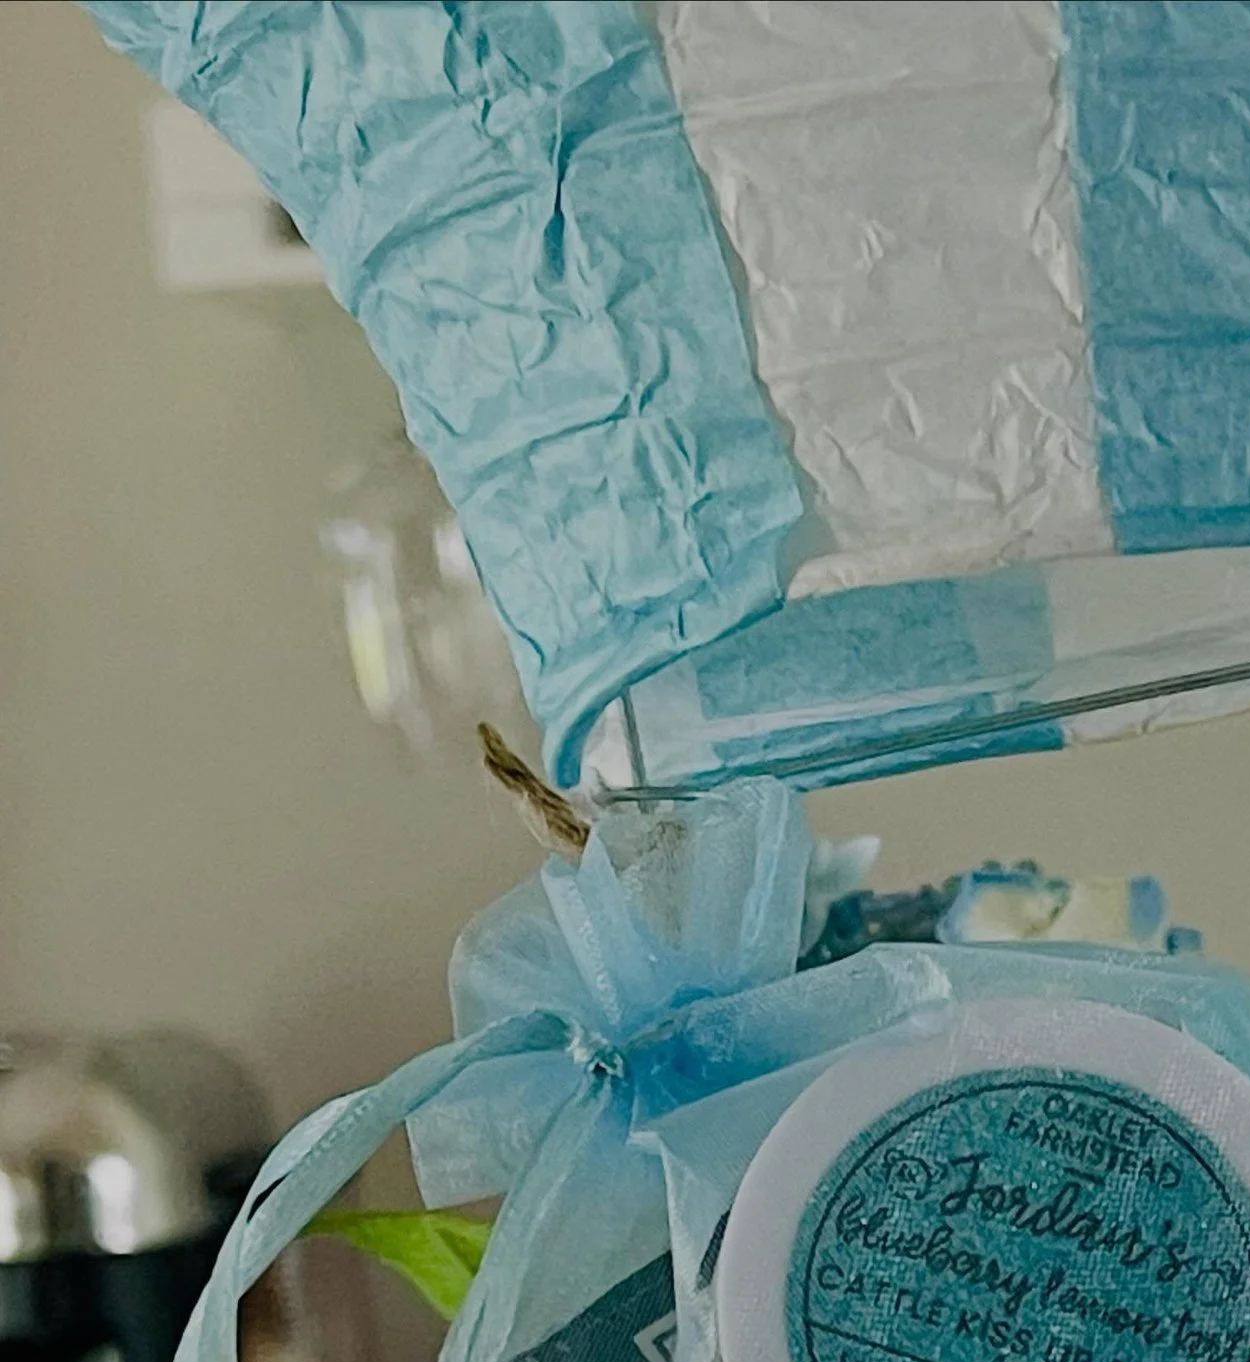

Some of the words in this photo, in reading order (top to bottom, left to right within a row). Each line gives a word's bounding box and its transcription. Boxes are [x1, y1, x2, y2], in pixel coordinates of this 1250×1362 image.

[1003, 1107, 1186, 1193] FARMSTEAD
[1038, 1089, 1158, 1152] OAKLEY
[813, 1259, 949, 1329] CATTLE
[953, 1307, 1037, 1358] KISS
